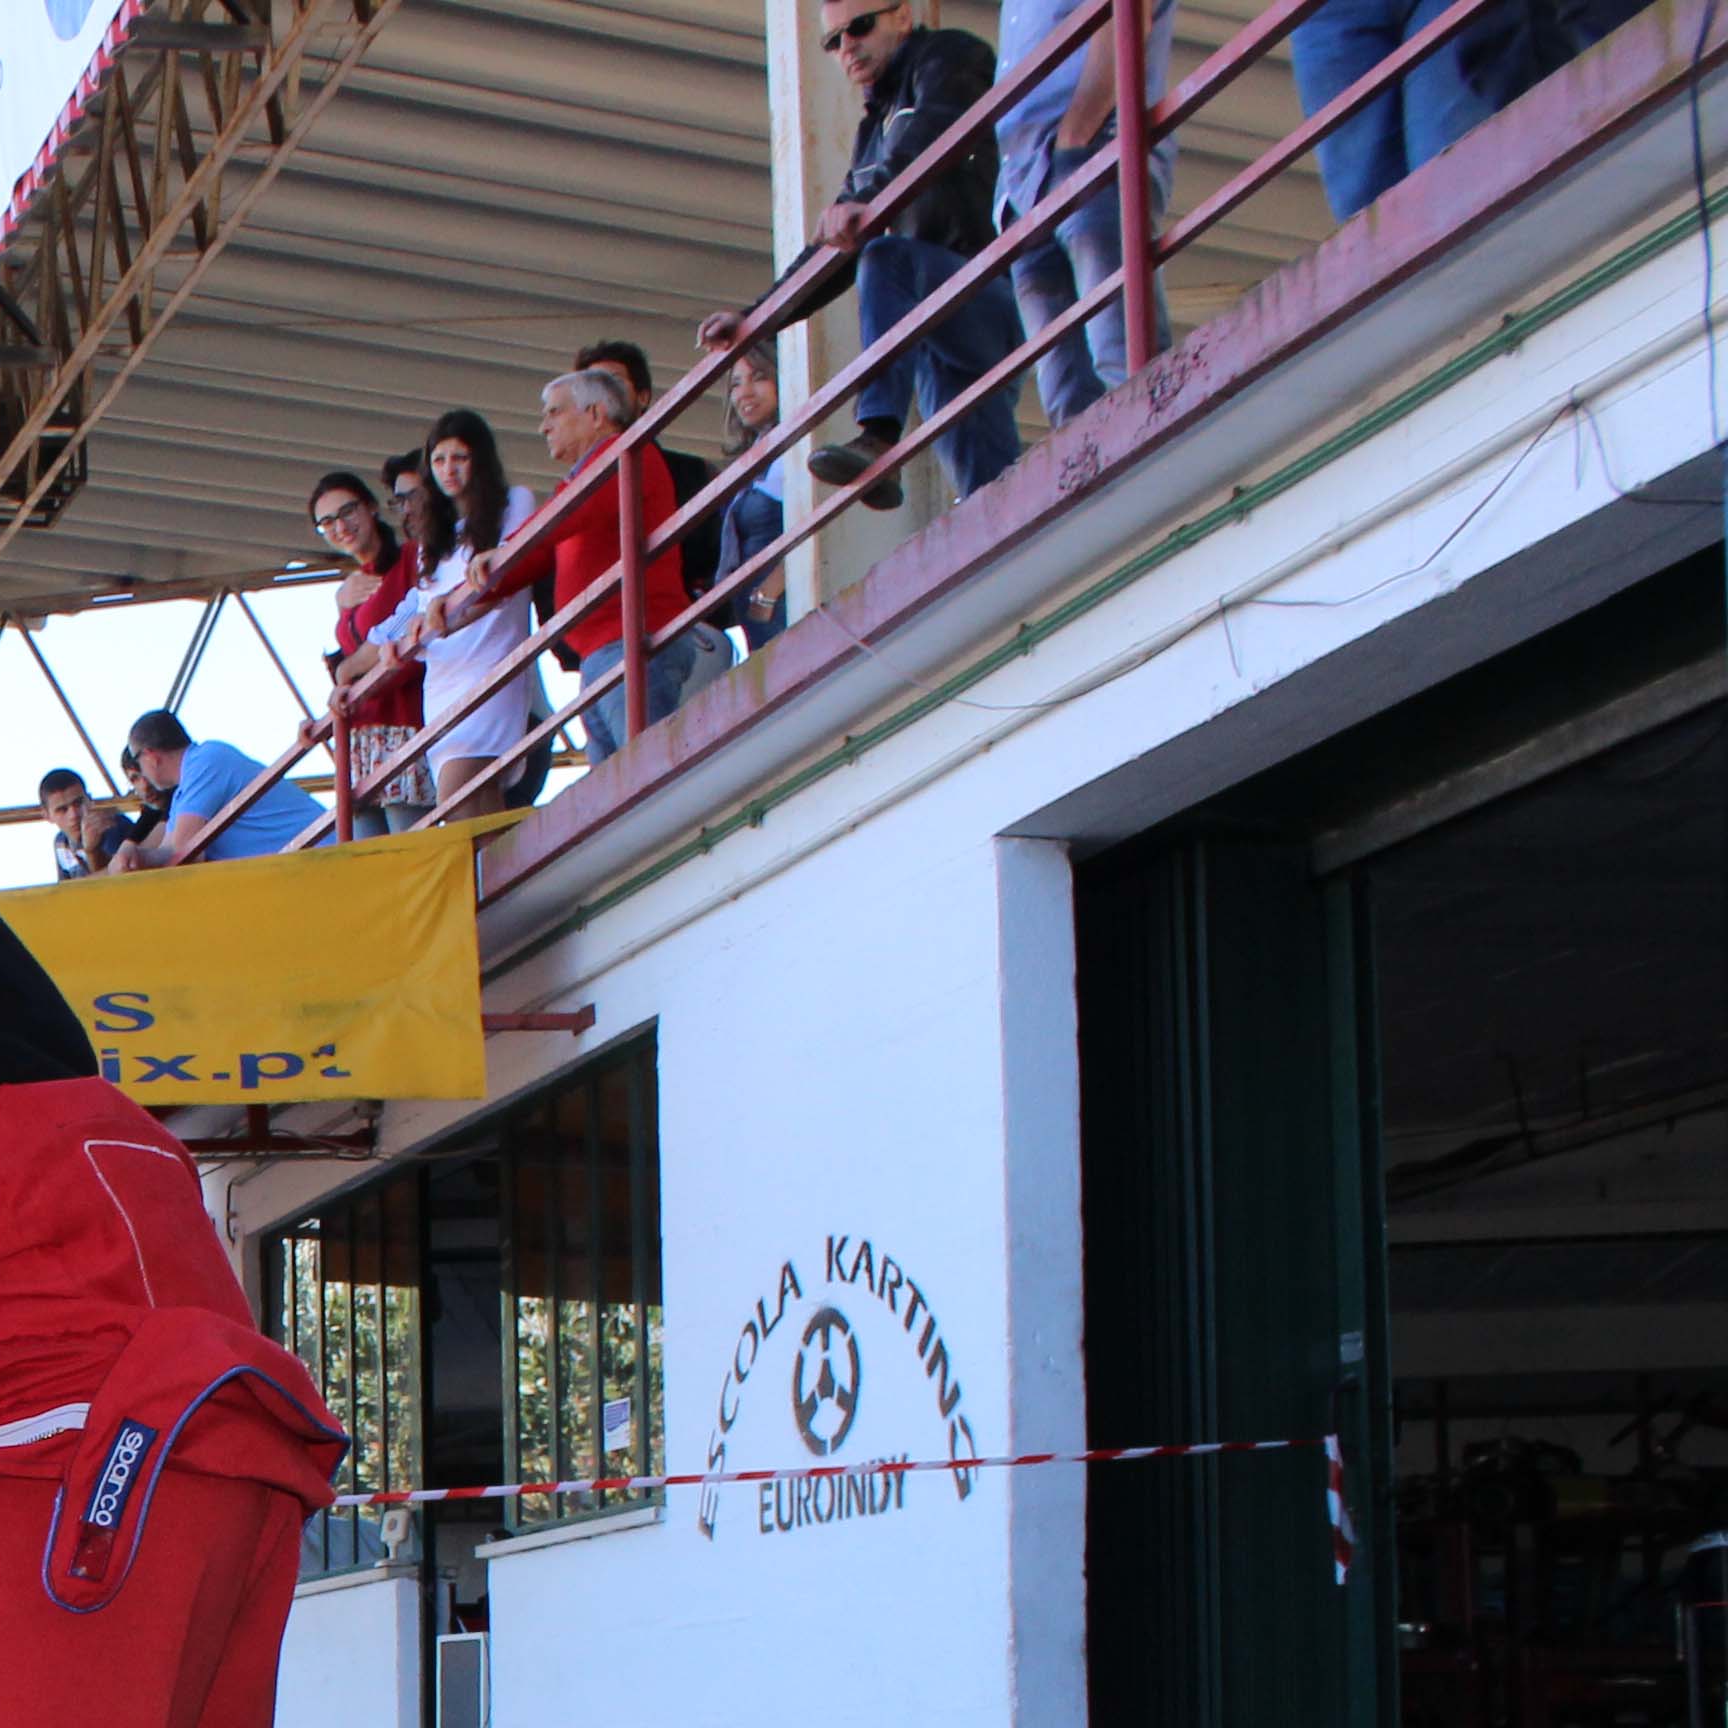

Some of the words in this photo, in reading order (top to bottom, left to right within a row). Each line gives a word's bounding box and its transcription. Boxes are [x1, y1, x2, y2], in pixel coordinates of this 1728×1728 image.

[698, 1259, 803, 1542] ESCOLA
[825, 1234, 979, 1502] KARTING
[95, 1431, 144, 1527] sparco
[758, 1453, 909, 1535] EUROINDY
